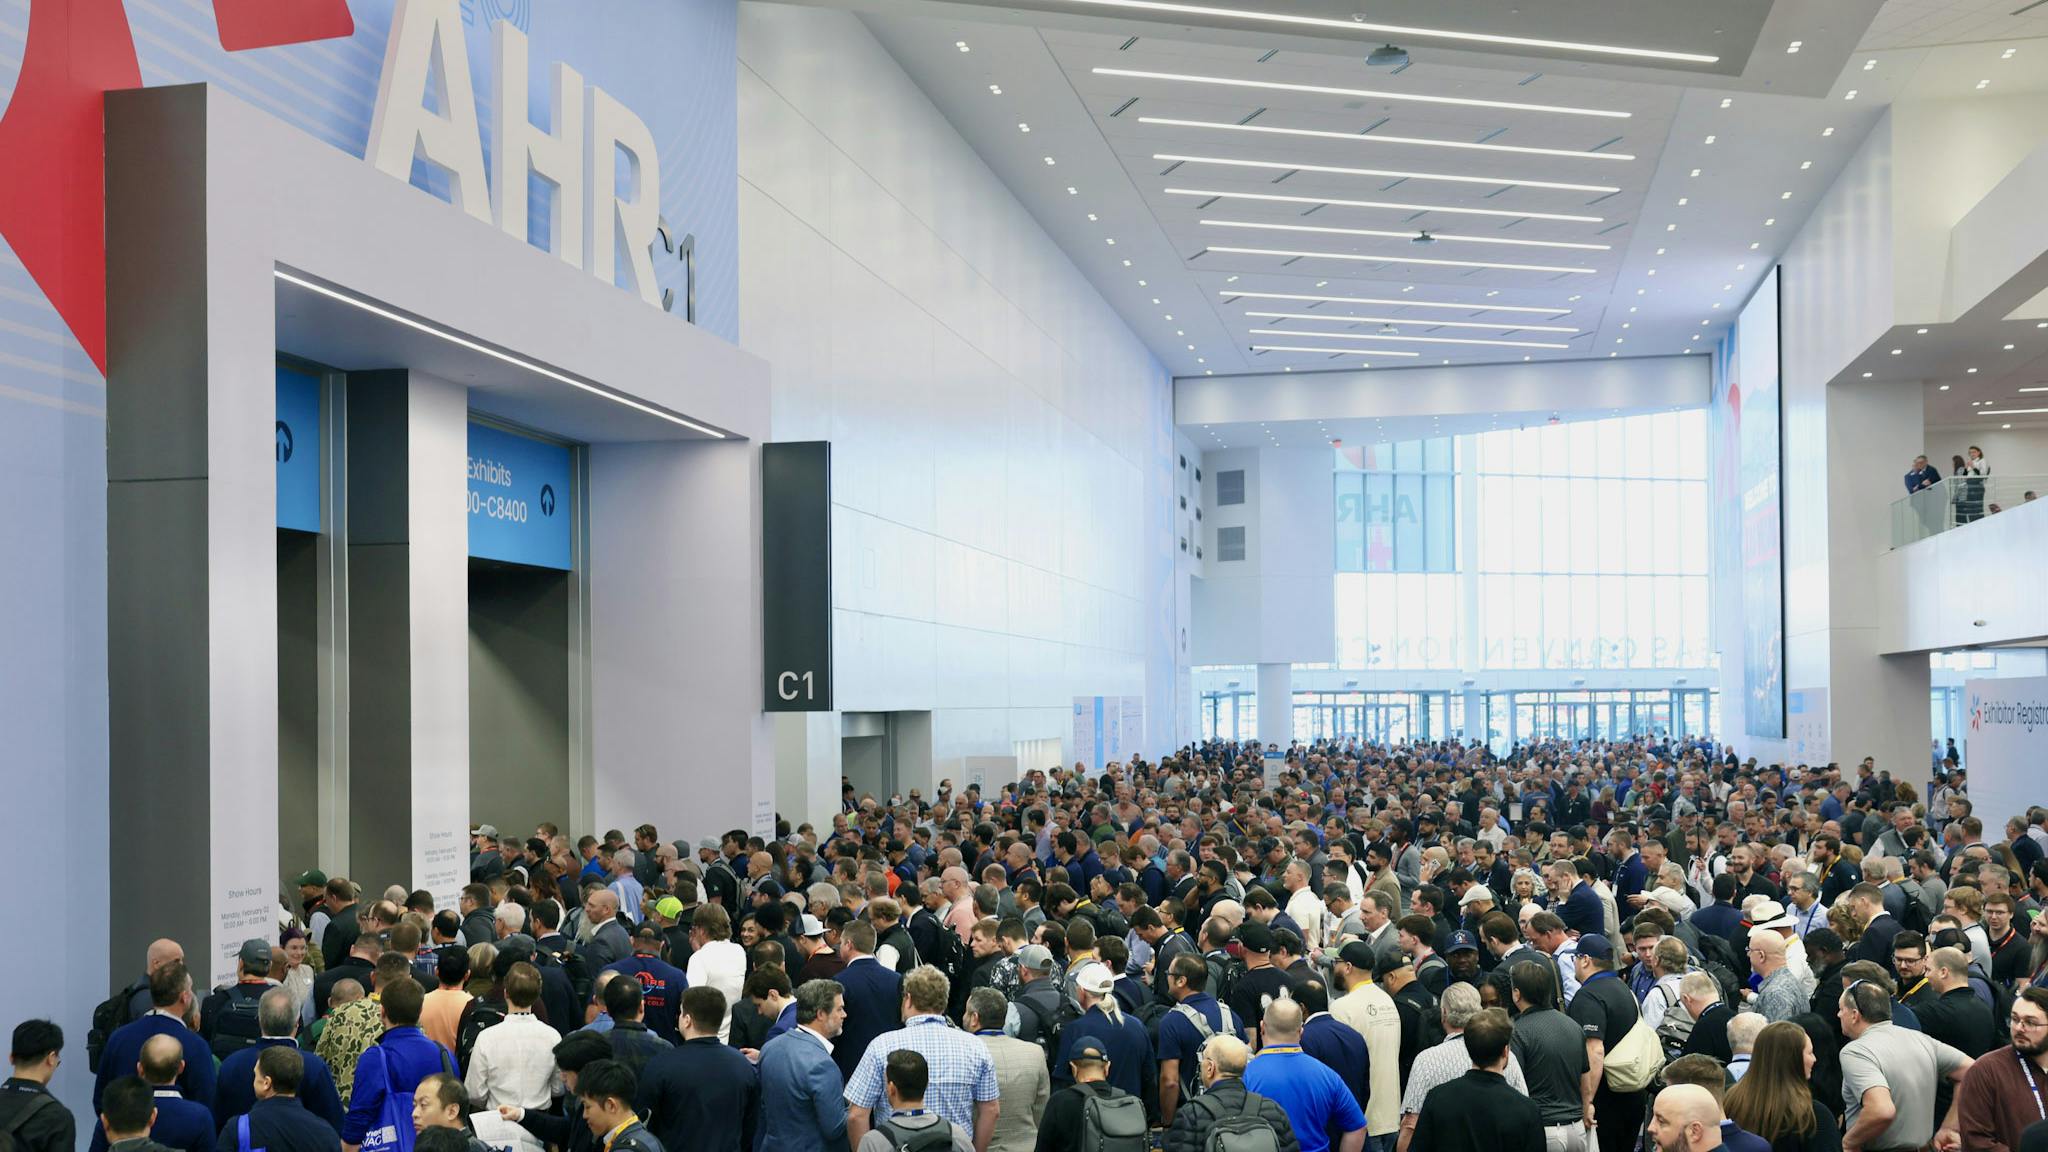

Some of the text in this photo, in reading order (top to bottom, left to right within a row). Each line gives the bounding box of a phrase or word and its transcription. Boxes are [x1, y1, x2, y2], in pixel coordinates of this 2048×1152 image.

[364, 0, 664, 312] AHR
[467, 457, 512, 487] Exhibits
[778, 670, 814, 701] C1
[1984, 700, 2016, 724] Exhibitor
[361, 1135, 383, 1148] VAC
